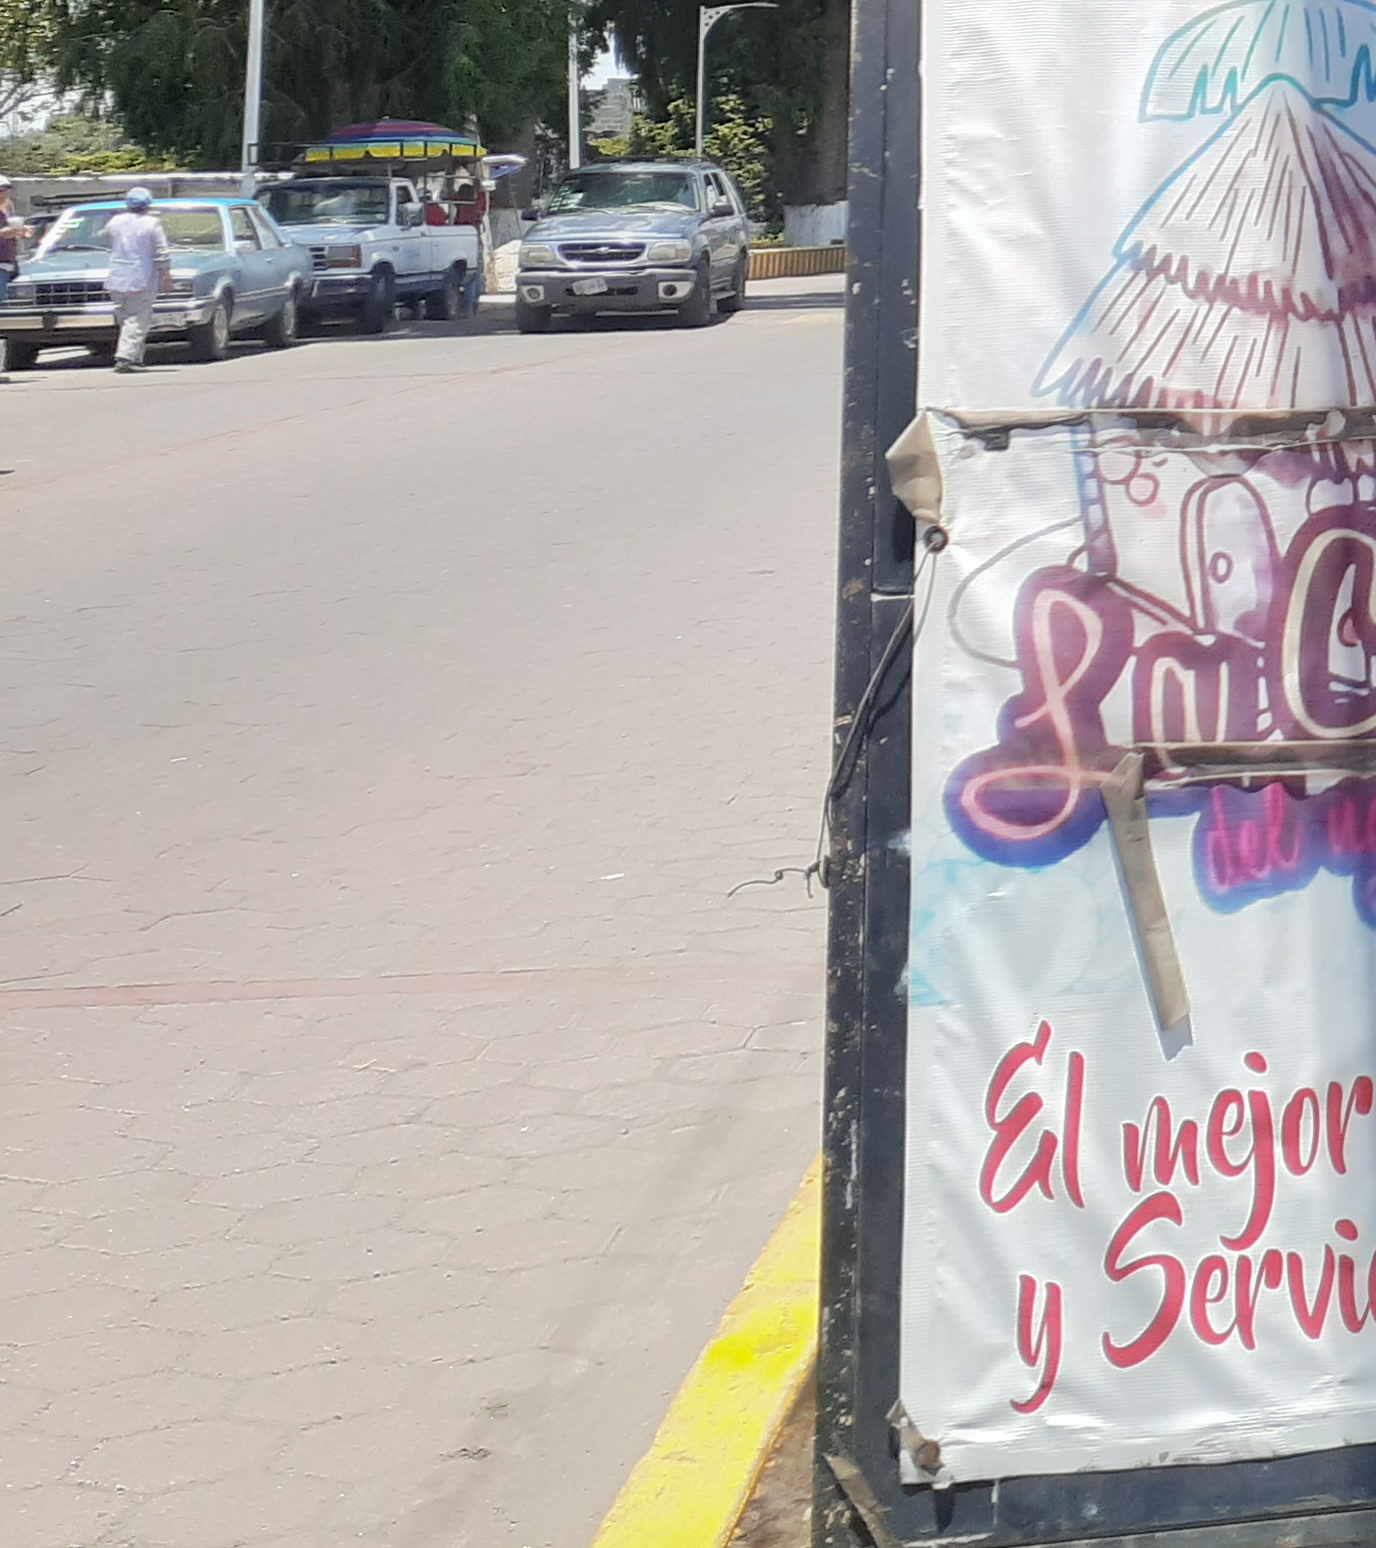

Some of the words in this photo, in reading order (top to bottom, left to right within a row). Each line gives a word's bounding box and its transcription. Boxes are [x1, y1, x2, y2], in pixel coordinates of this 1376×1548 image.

[959, 587, 1232, 841] La
[978, 1018, 1086, 1214] El
[1121, 1050, 1373, 1252] mejor
[1009, 1274, 1062, 1414] y
